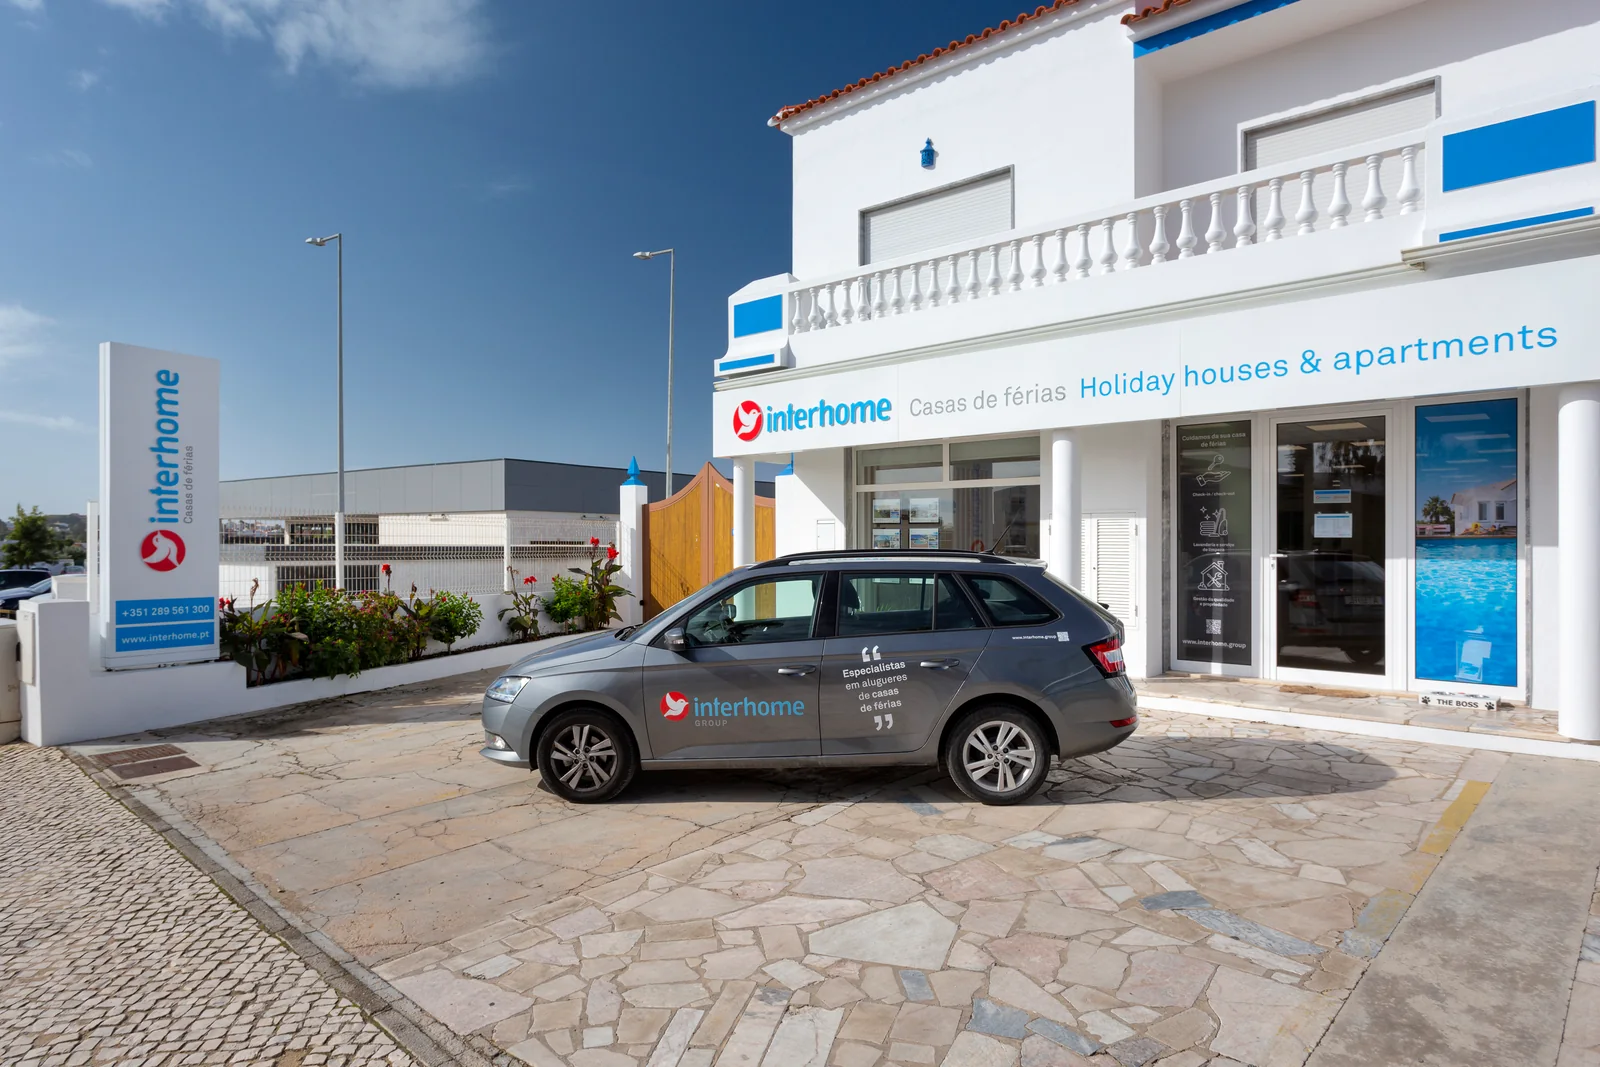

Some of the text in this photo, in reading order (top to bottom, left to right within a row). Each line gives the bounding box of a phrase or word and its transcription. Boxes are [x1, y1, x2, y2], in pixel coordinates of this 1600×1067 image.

[766, 325, 1558, 433] interhome Casas de férias Holiday houses & apartments
[148, 369, 180, 523] interhome
[183, 446, 193, 524] Casas de férias
[122, 605, 210, 617] +351 289 561 300
[122, 631, 210, 644] www.interhome.pt
[1182, 638, 1247, 649] www.interhome.group
[842, 661, 906, 678] Especialistas
[845, 674, 908, 690] em alugueres
[858, 687, 899, 701] de casas
[693, 696, 805, 717] interhome
[860, 699, 902, 712] de férias
[1436, 698, 1479, 708] THE BOSS
[694, 719, 728, 727] GROUP
